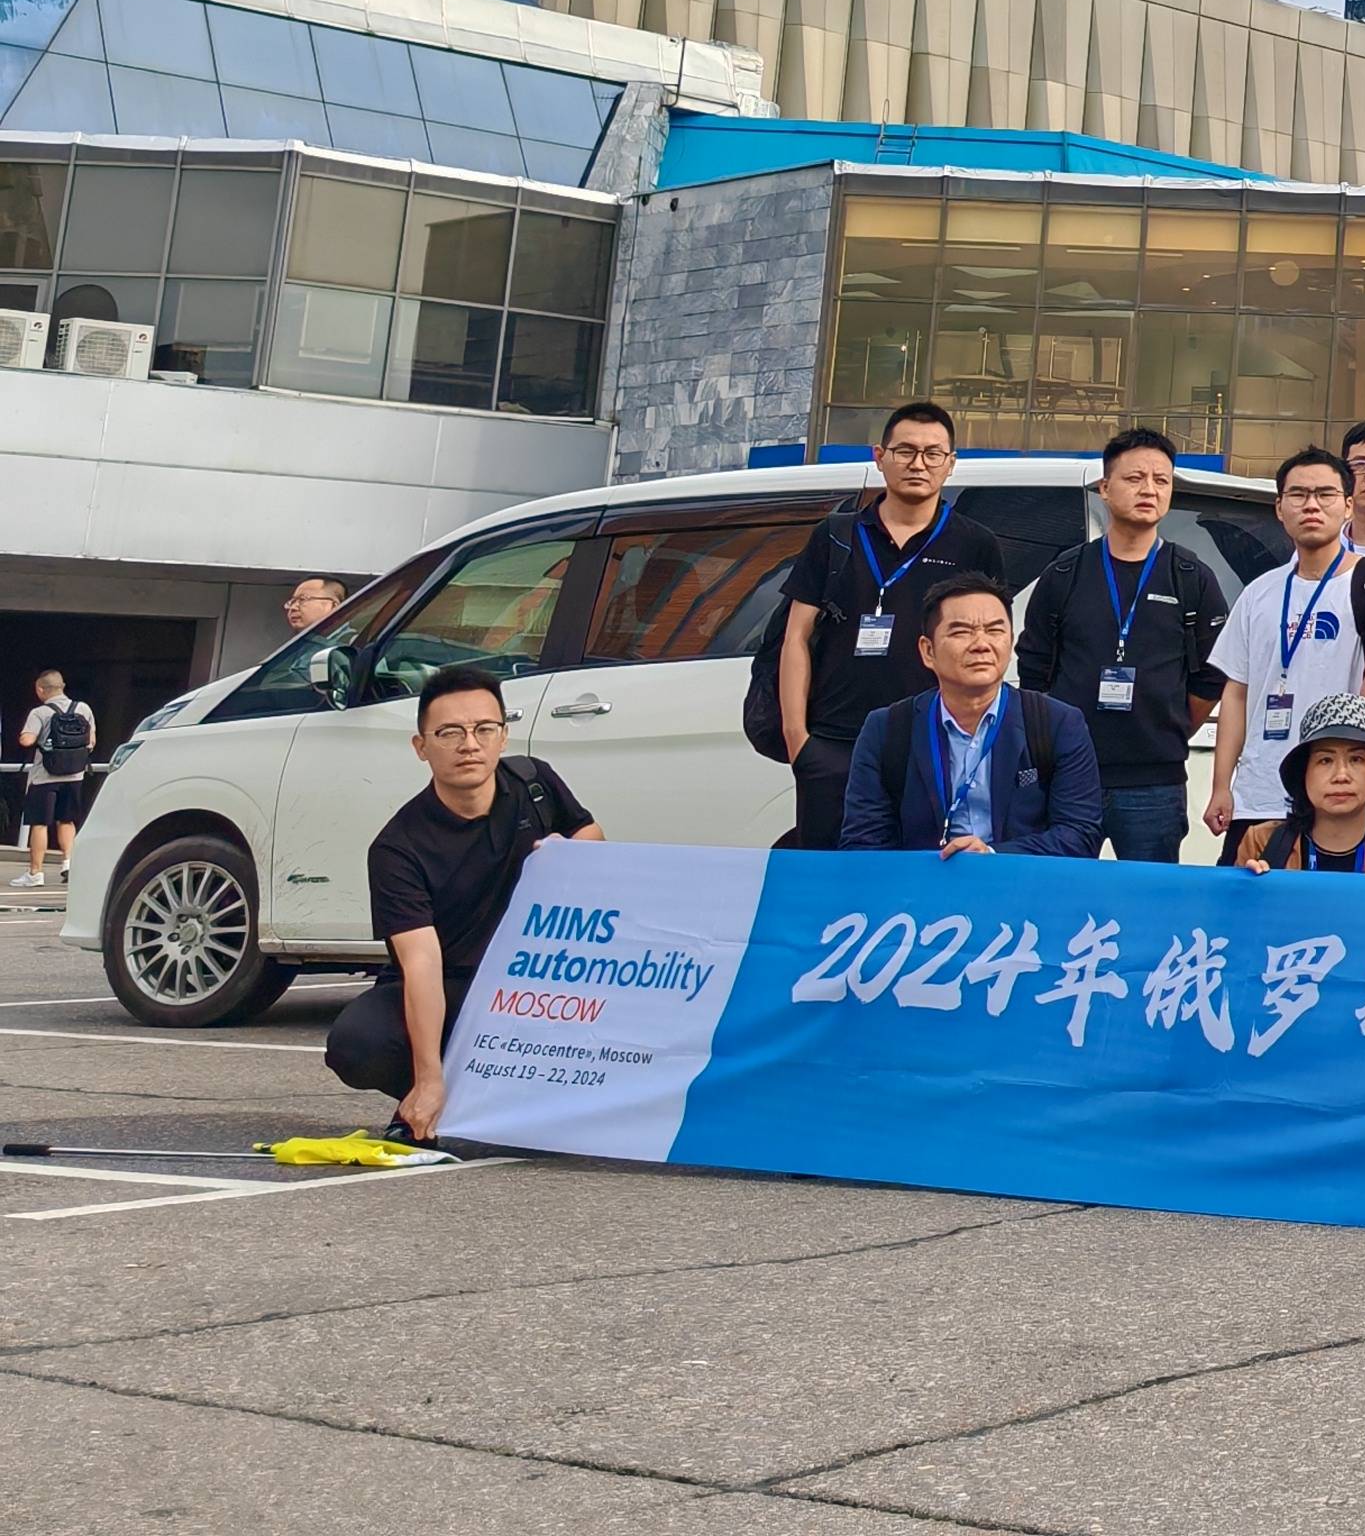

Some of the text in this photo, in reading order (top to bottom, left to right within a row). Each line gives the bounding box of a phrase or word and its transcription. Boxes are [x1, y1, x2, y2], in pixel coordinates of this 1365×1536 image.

[521, 903, 620, 944] MIMS
[507, 948, 715, 1002] automobility
[489, 989, 607, 1023] MOSCOW
[473, 1033, 653, 1064] IEC «Expocentre», Moscow
[465, 1058, 516, 1079] August
[518, 1064, 536, 1079] 19
[547, 1067, 568, 1086] 22,
[571, 1070, 606, 1086] 2024
